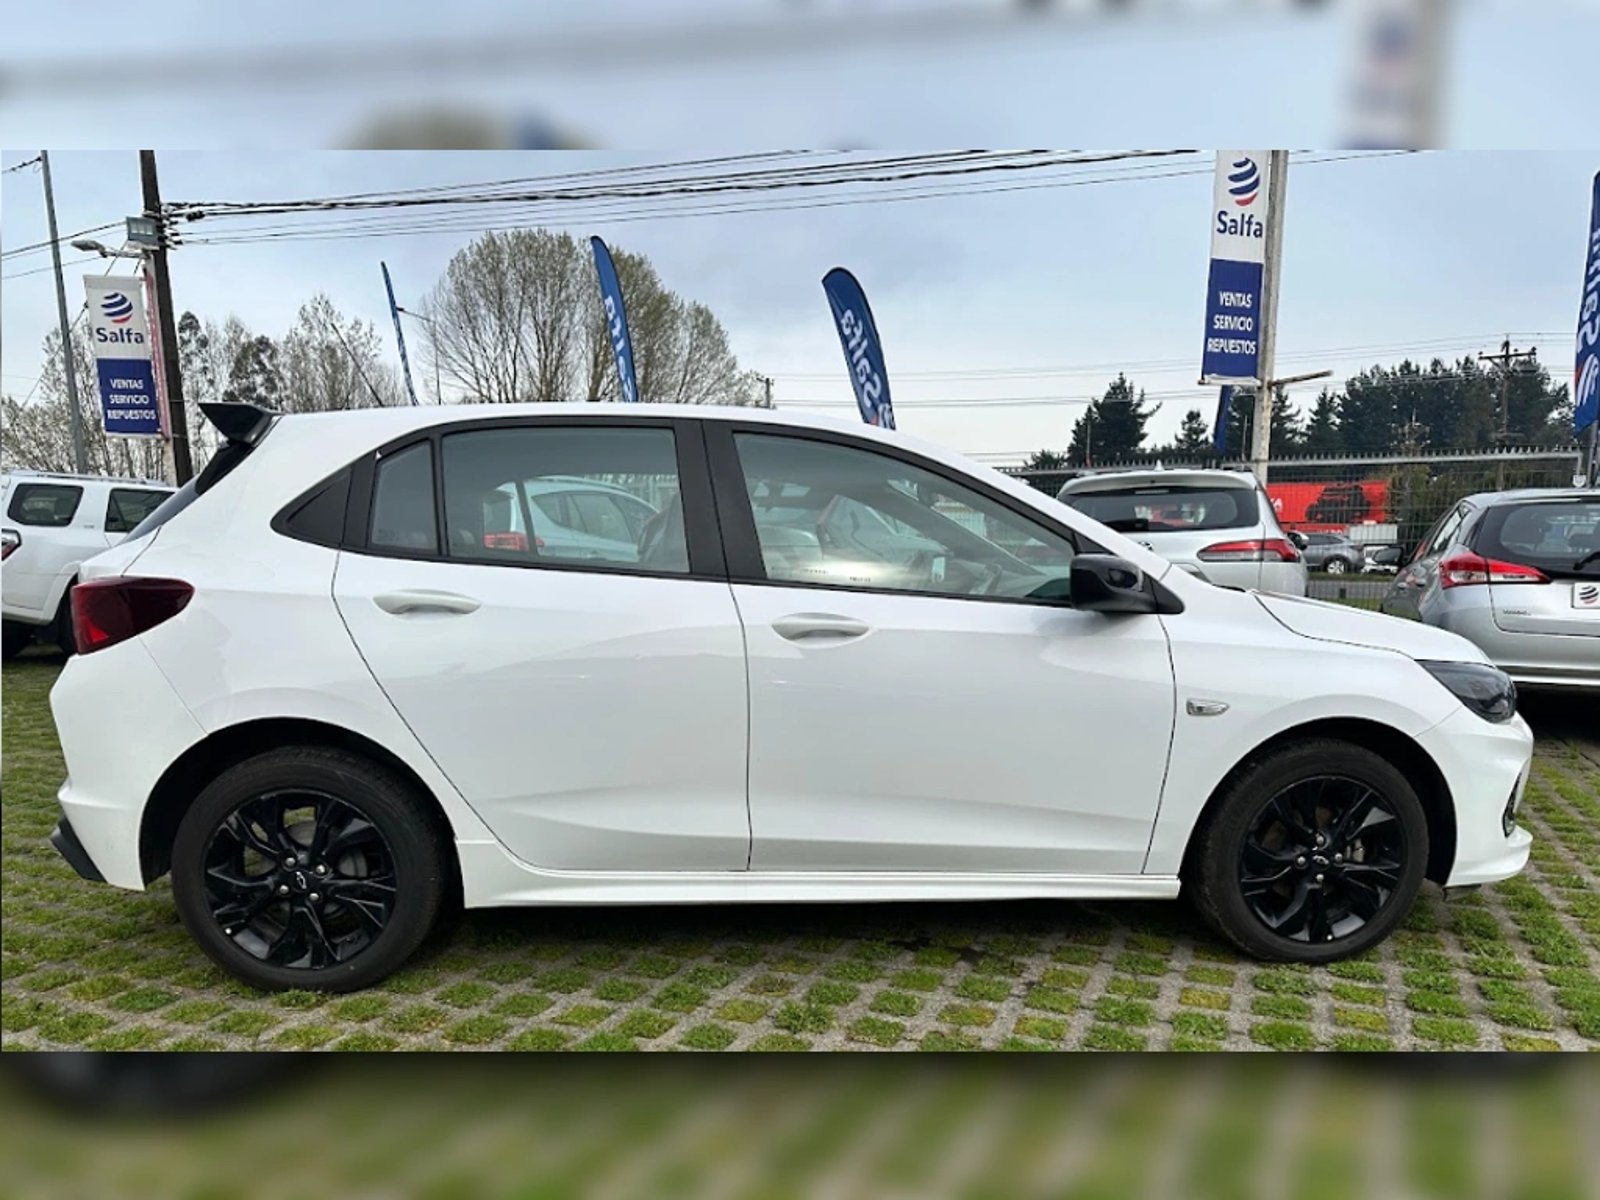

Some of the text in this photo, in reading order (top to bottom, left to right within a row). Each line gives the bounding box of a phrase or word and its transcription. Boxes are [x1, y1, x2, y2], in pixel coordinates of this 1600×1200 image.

[1216, 209, 1264, 239] Salfa
[1219, 291, 1252, 308] VENTAS
[1213, 314, 1253, 331] SERVICIO
[95, 327, 145, 345] Salfa
[1207, 337, 1256, 354] REPUESTOS
[110, 378, 144, 389] VENTAS
[109, 394, 149, 404] SERVICIO
[107, 409, 156, 420] REPUESTOS
